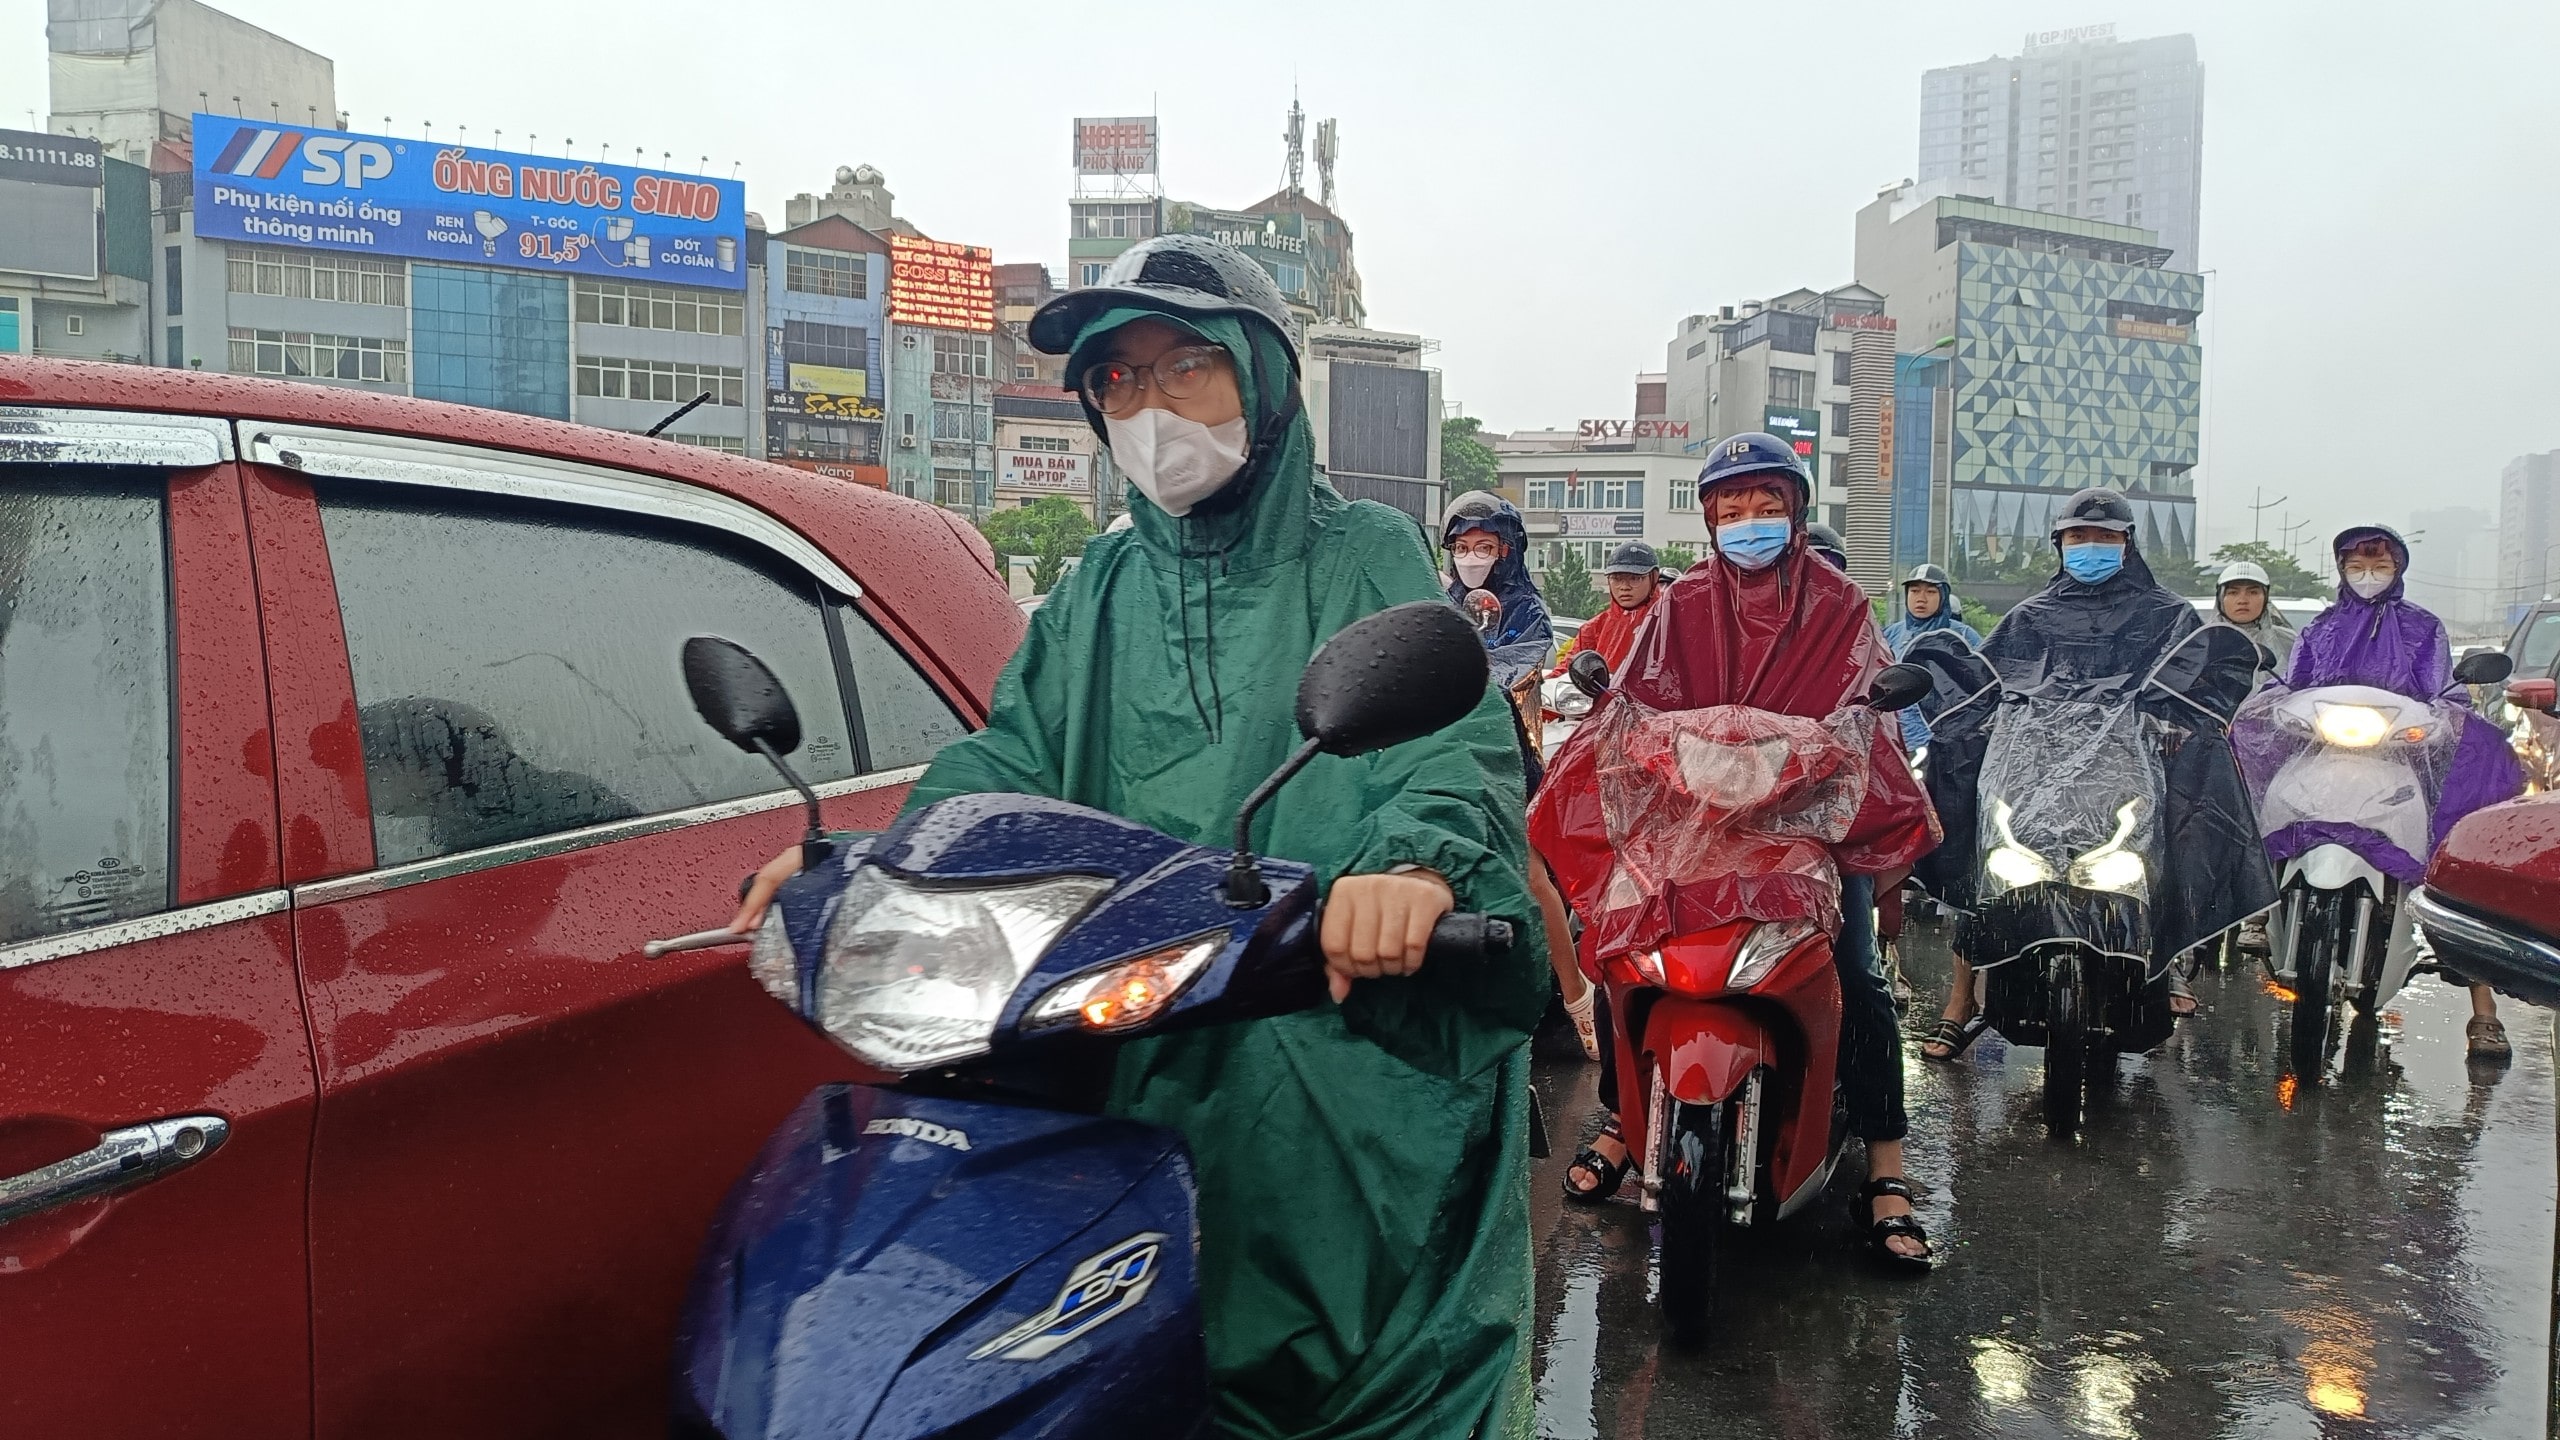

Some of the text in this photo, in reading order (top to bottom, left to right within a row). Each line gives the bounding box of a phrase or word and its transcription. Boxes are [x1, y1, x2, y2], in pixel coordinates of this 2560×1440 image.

[1080, 125, 1152, 150] HOTEL
[432, 148, 721, 221] ỐNG NƯỚC SINO
[213, 187, 402, 226] Phụ kiện nối ống
[435, 215, 464, 229] REN
[548, 216, 578, 230] GÓC
[243, 216, 374, 245] thông minh
[427, 230, 473, 245] NGOÀI
[674, 237, 701, 252] ĐỐT
[1261, 231, 1302, 254] COFFEE
[661, 252, 681, 265] CO
[893, 263, 946, 281] GOSS
[773, 392, 795, 405] SỐ 2
[1579, 419, 1689, 438] SKY GYM
[1726, 441, 1750, 456] ila
[1794, 441, 1812, 454] 200K
[1881, 412, 1892, 477] HOTEL
[1012, 456, 1075, 470] MUA BÁN
[814, 465, 855, 481] Wang
[1023, 469, 1067, 482] LAPTOP
[1591, 517, 1614, 529] GYM
[101, 859, 118, 867] KIA
[861, 1118, 972, 1151] HONDA
